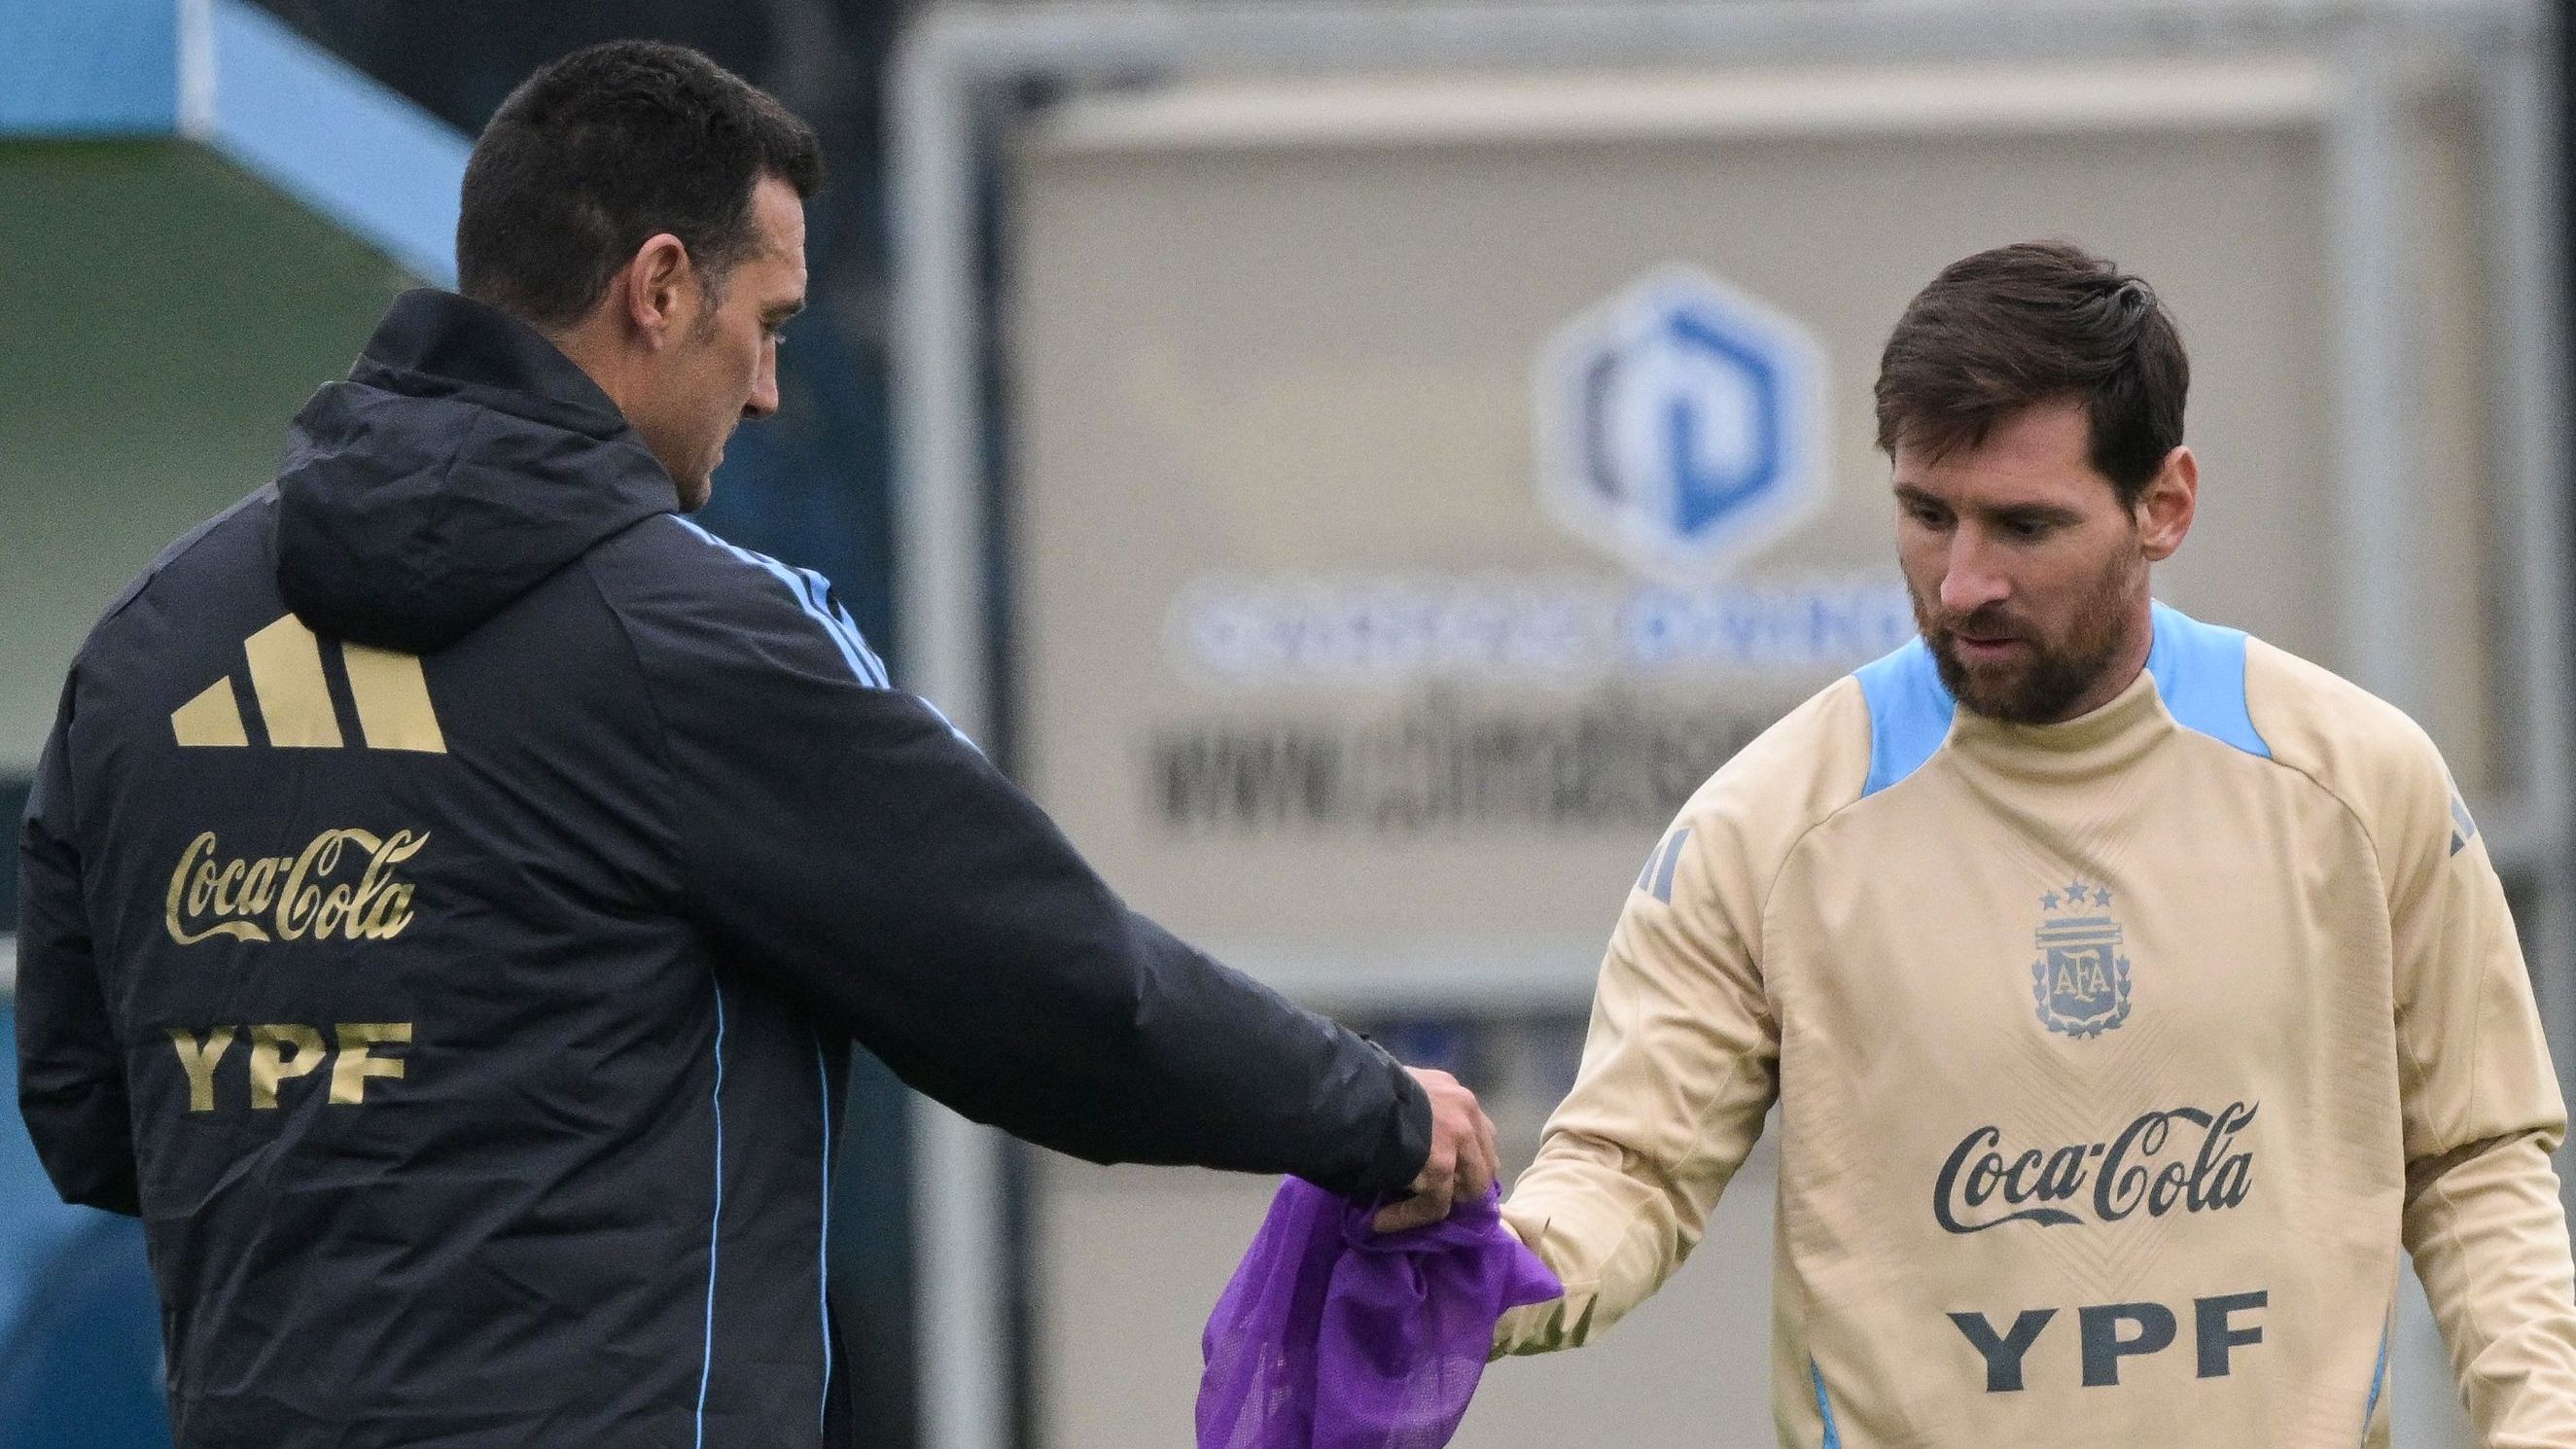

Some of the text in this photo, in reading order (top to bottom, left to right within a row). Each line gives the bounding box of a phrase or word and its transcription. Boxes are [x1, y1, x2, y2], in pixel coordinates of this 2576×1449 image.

[166, 828, 431, 945] Coca-Cola
[2054, 948, 2112, 1003] AFA
[166, 1022, 412, 1112] YPF
[1933, 1100, 2260, 1235] Coca-Cola
[1946, 1290, 2269, 1394] YPF
